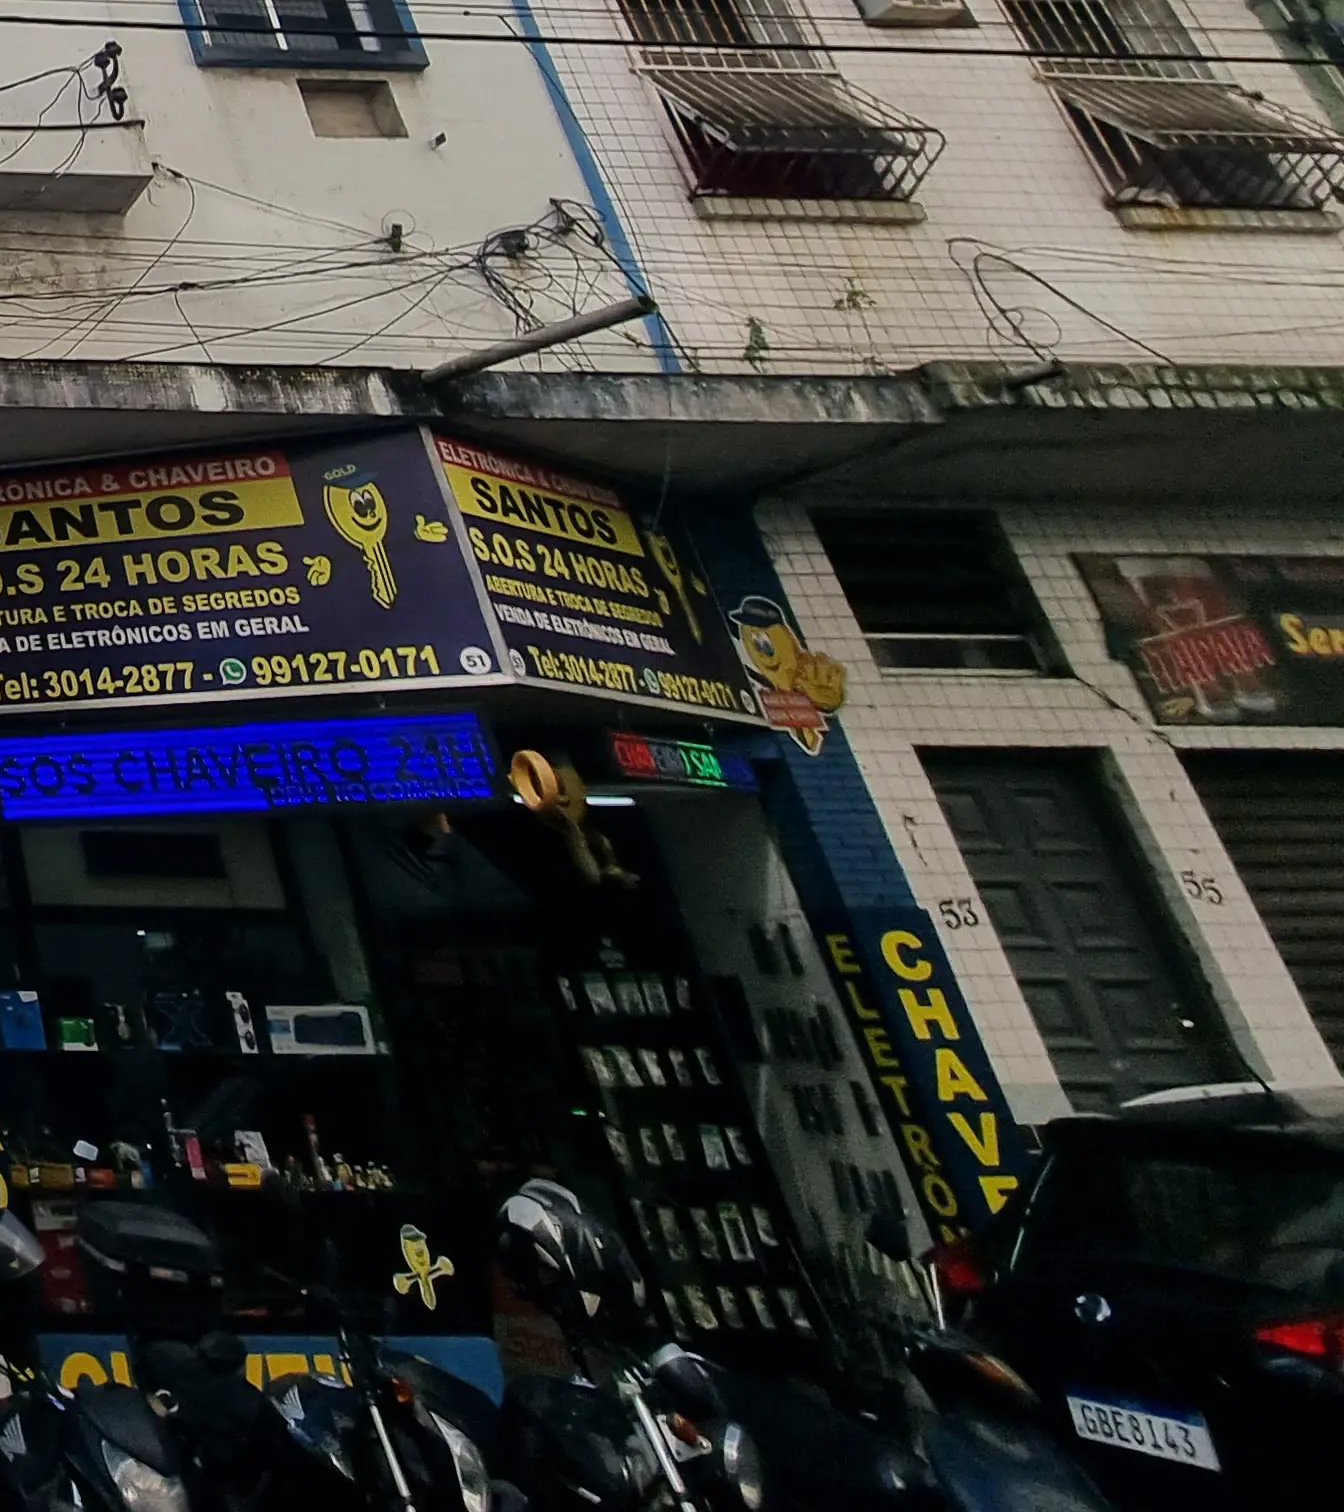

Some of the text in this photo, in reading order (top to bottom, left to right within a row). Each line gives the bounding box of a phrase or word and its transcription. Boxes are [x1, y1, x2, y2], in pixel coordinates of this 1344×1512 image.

[101, 473, 120, 491] &
[128, 456, 276, 488] CHAVEIRO
[323, 464, 356, 481] GOLD
[471, 476, 618, 544] SANTOS
[57, 557, 111, 591] 24
[123, 541, 288, 586] HORAS
[469, 527, 649, 598] S.O.S 24 HORAS
[54, 605, 67, 622] E
[71, 600, 144, 621] TROCA
[148, 596, 178, 615] DE
[182, 586, 301, 613] SEGREDOS
[485, 574, 548, 605] ABERTURA
[548, 588, 557, 606] E
[557, 590, 594, 613] TROCA
[592, 598, 611, 617] DE
[17, 634, 43, 652] DE
[47, 622, 191, 651] ELETRÔNICOS
[197, 620, 230, 639] EM
[234, 614, 310, 637] GERAL
[494, 603, 536, 627] VENDA
[534, 611, 553, 631] DE
[251, 645, 440, 686] 99127-0171
[465, 654, 487, 668] 51
[0, 753, 96, 798] SOS
[114, 738, 371, 792] CHAVEIRO
[1180, 870, 1223, 906] 55
[938, 898, 979, 929] 53
[825, 932, 958, 1245] ELETRÔ
[1080, 1404, 1197, 1458] GBE8143
